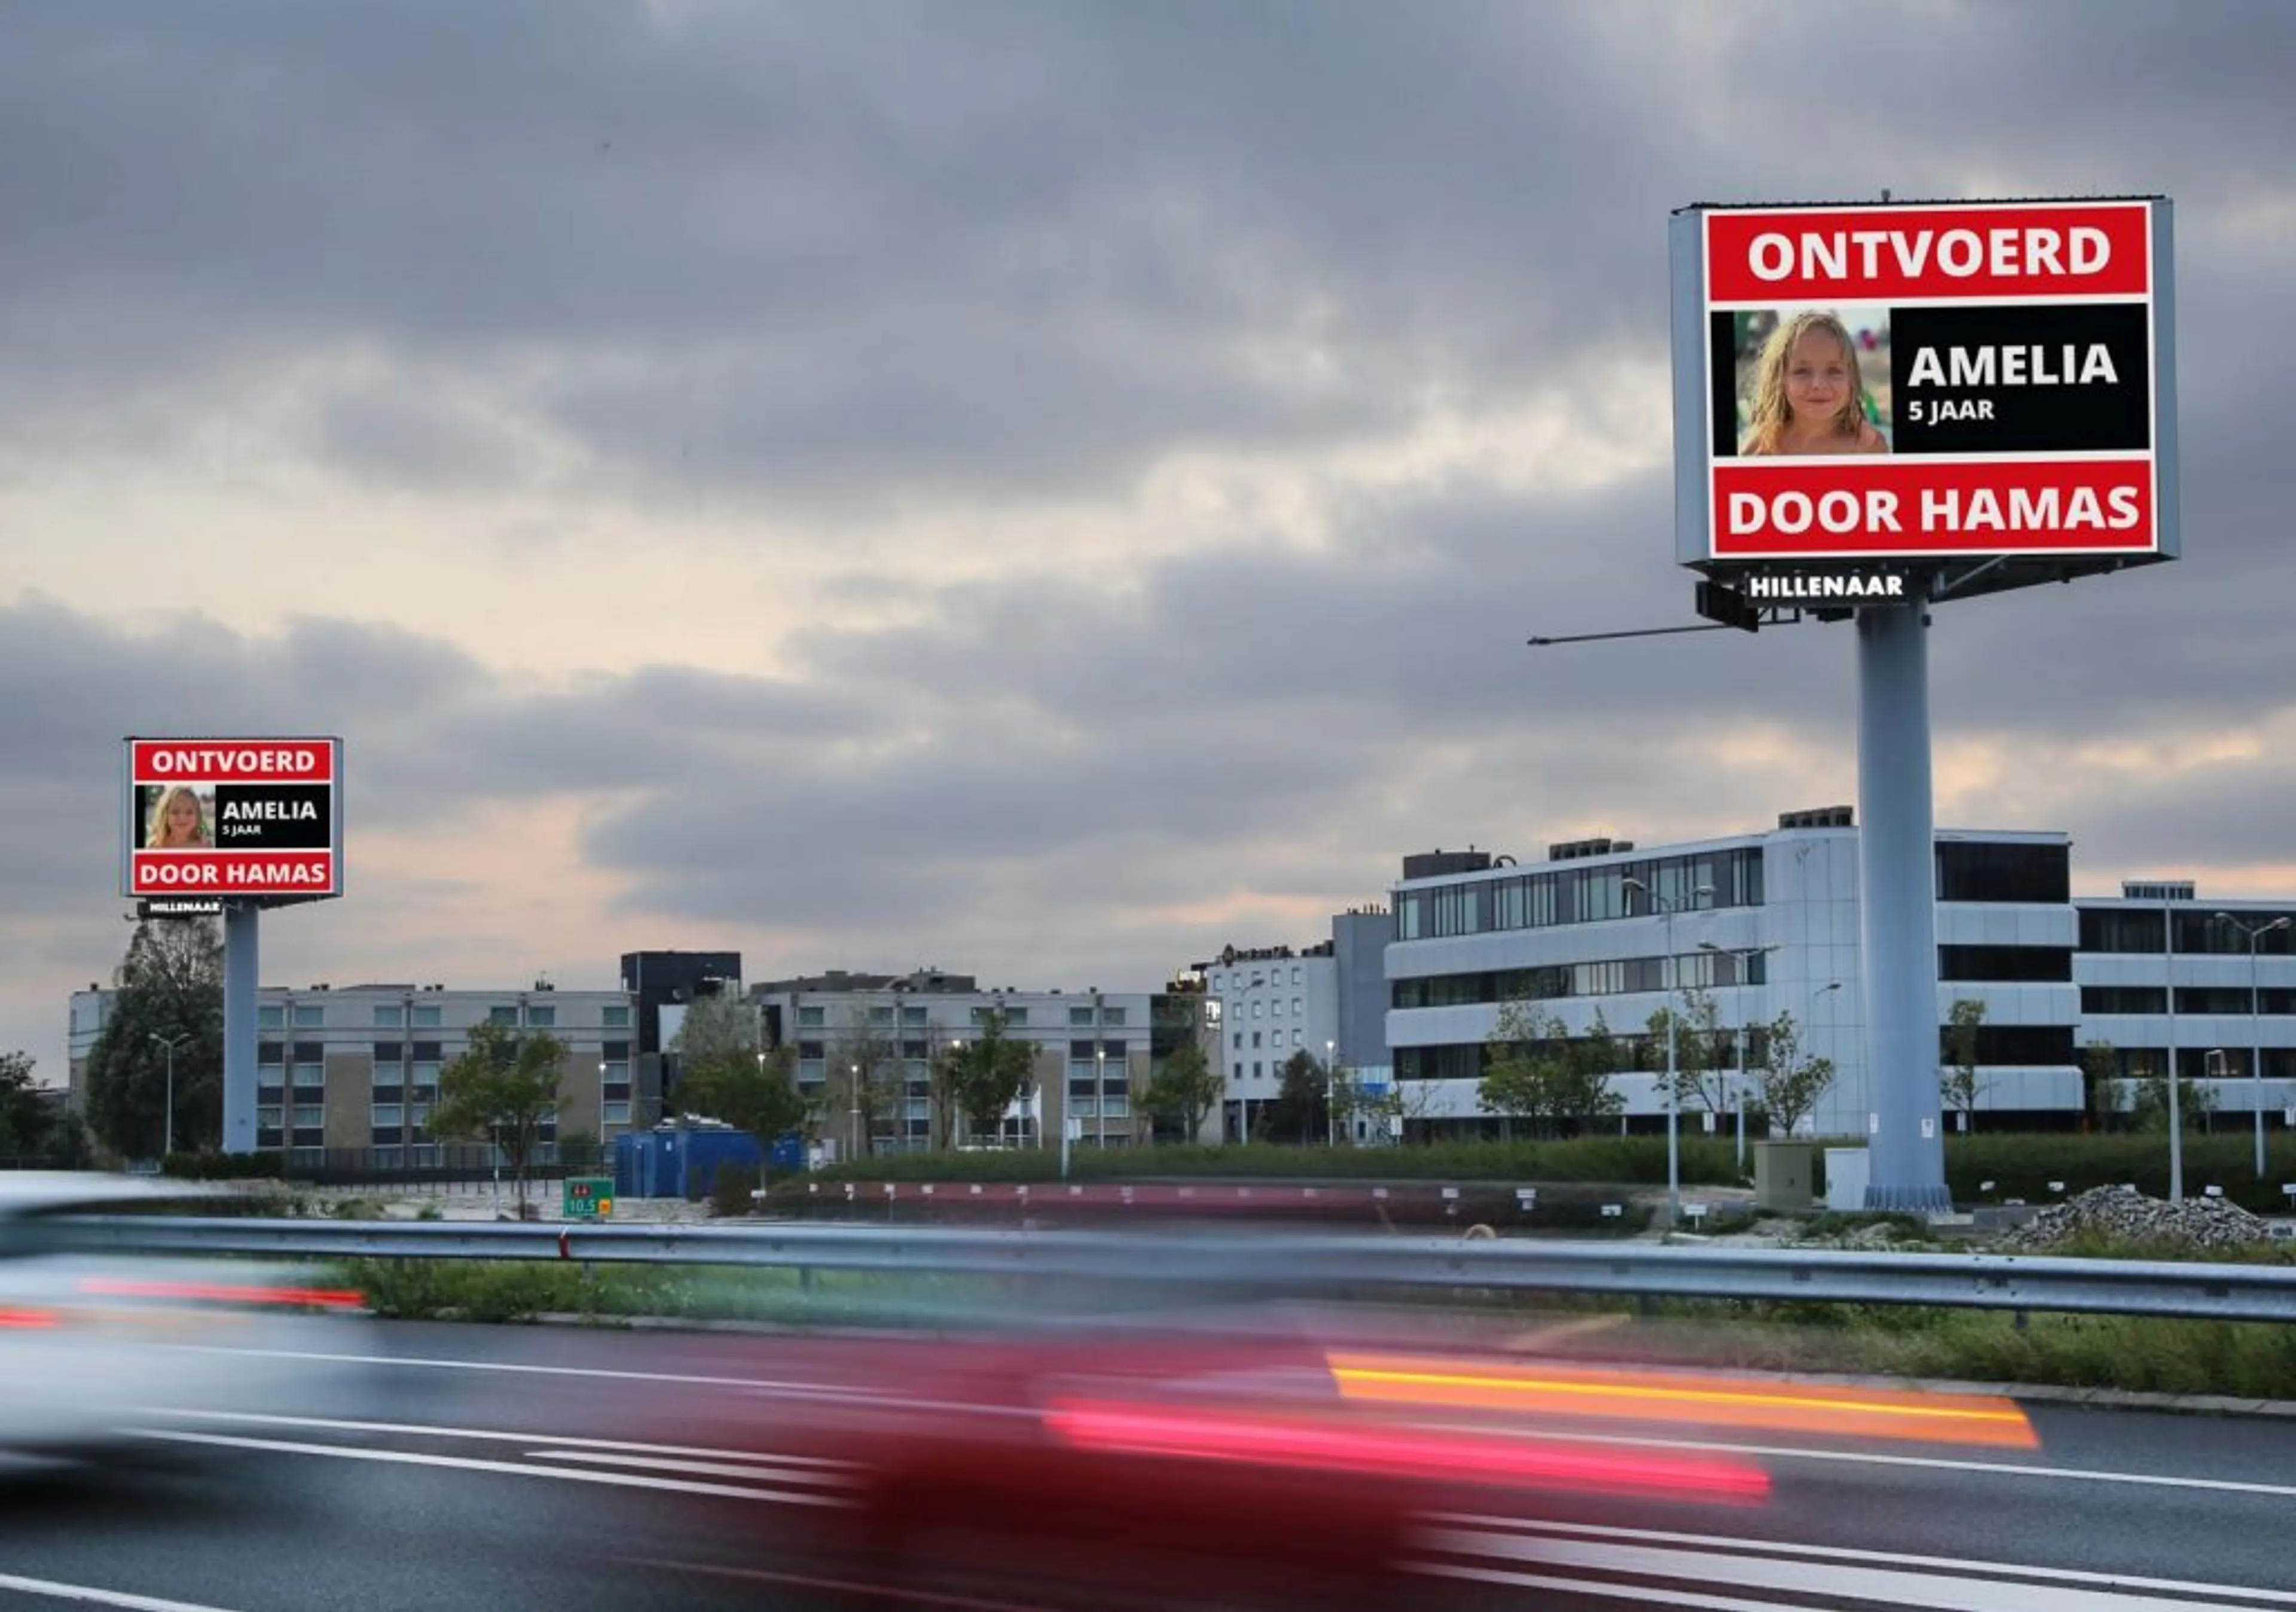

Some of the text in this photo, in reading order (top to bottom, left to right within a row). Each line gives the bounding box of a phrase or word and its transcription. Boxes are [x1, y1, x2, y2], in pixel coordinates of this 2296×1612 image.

[1748, 227, 2111, 282] ONTVOERD
[1907, 343, 2118, 387] AMELIA
[1909, 399, 1995, 426] 5 JAAR
[1729, 486, 2140, 535] DOOR HAMAS
[1750, 575, 1903, 597] HILLENAAR
[152, 750, 315, 773] ONTVOERD
[222, 801, 317, 820] AMELIA
[222, 825, 262, 837] 5 JAAR
[141, 863, 326, 884] DOOR HAMAS
